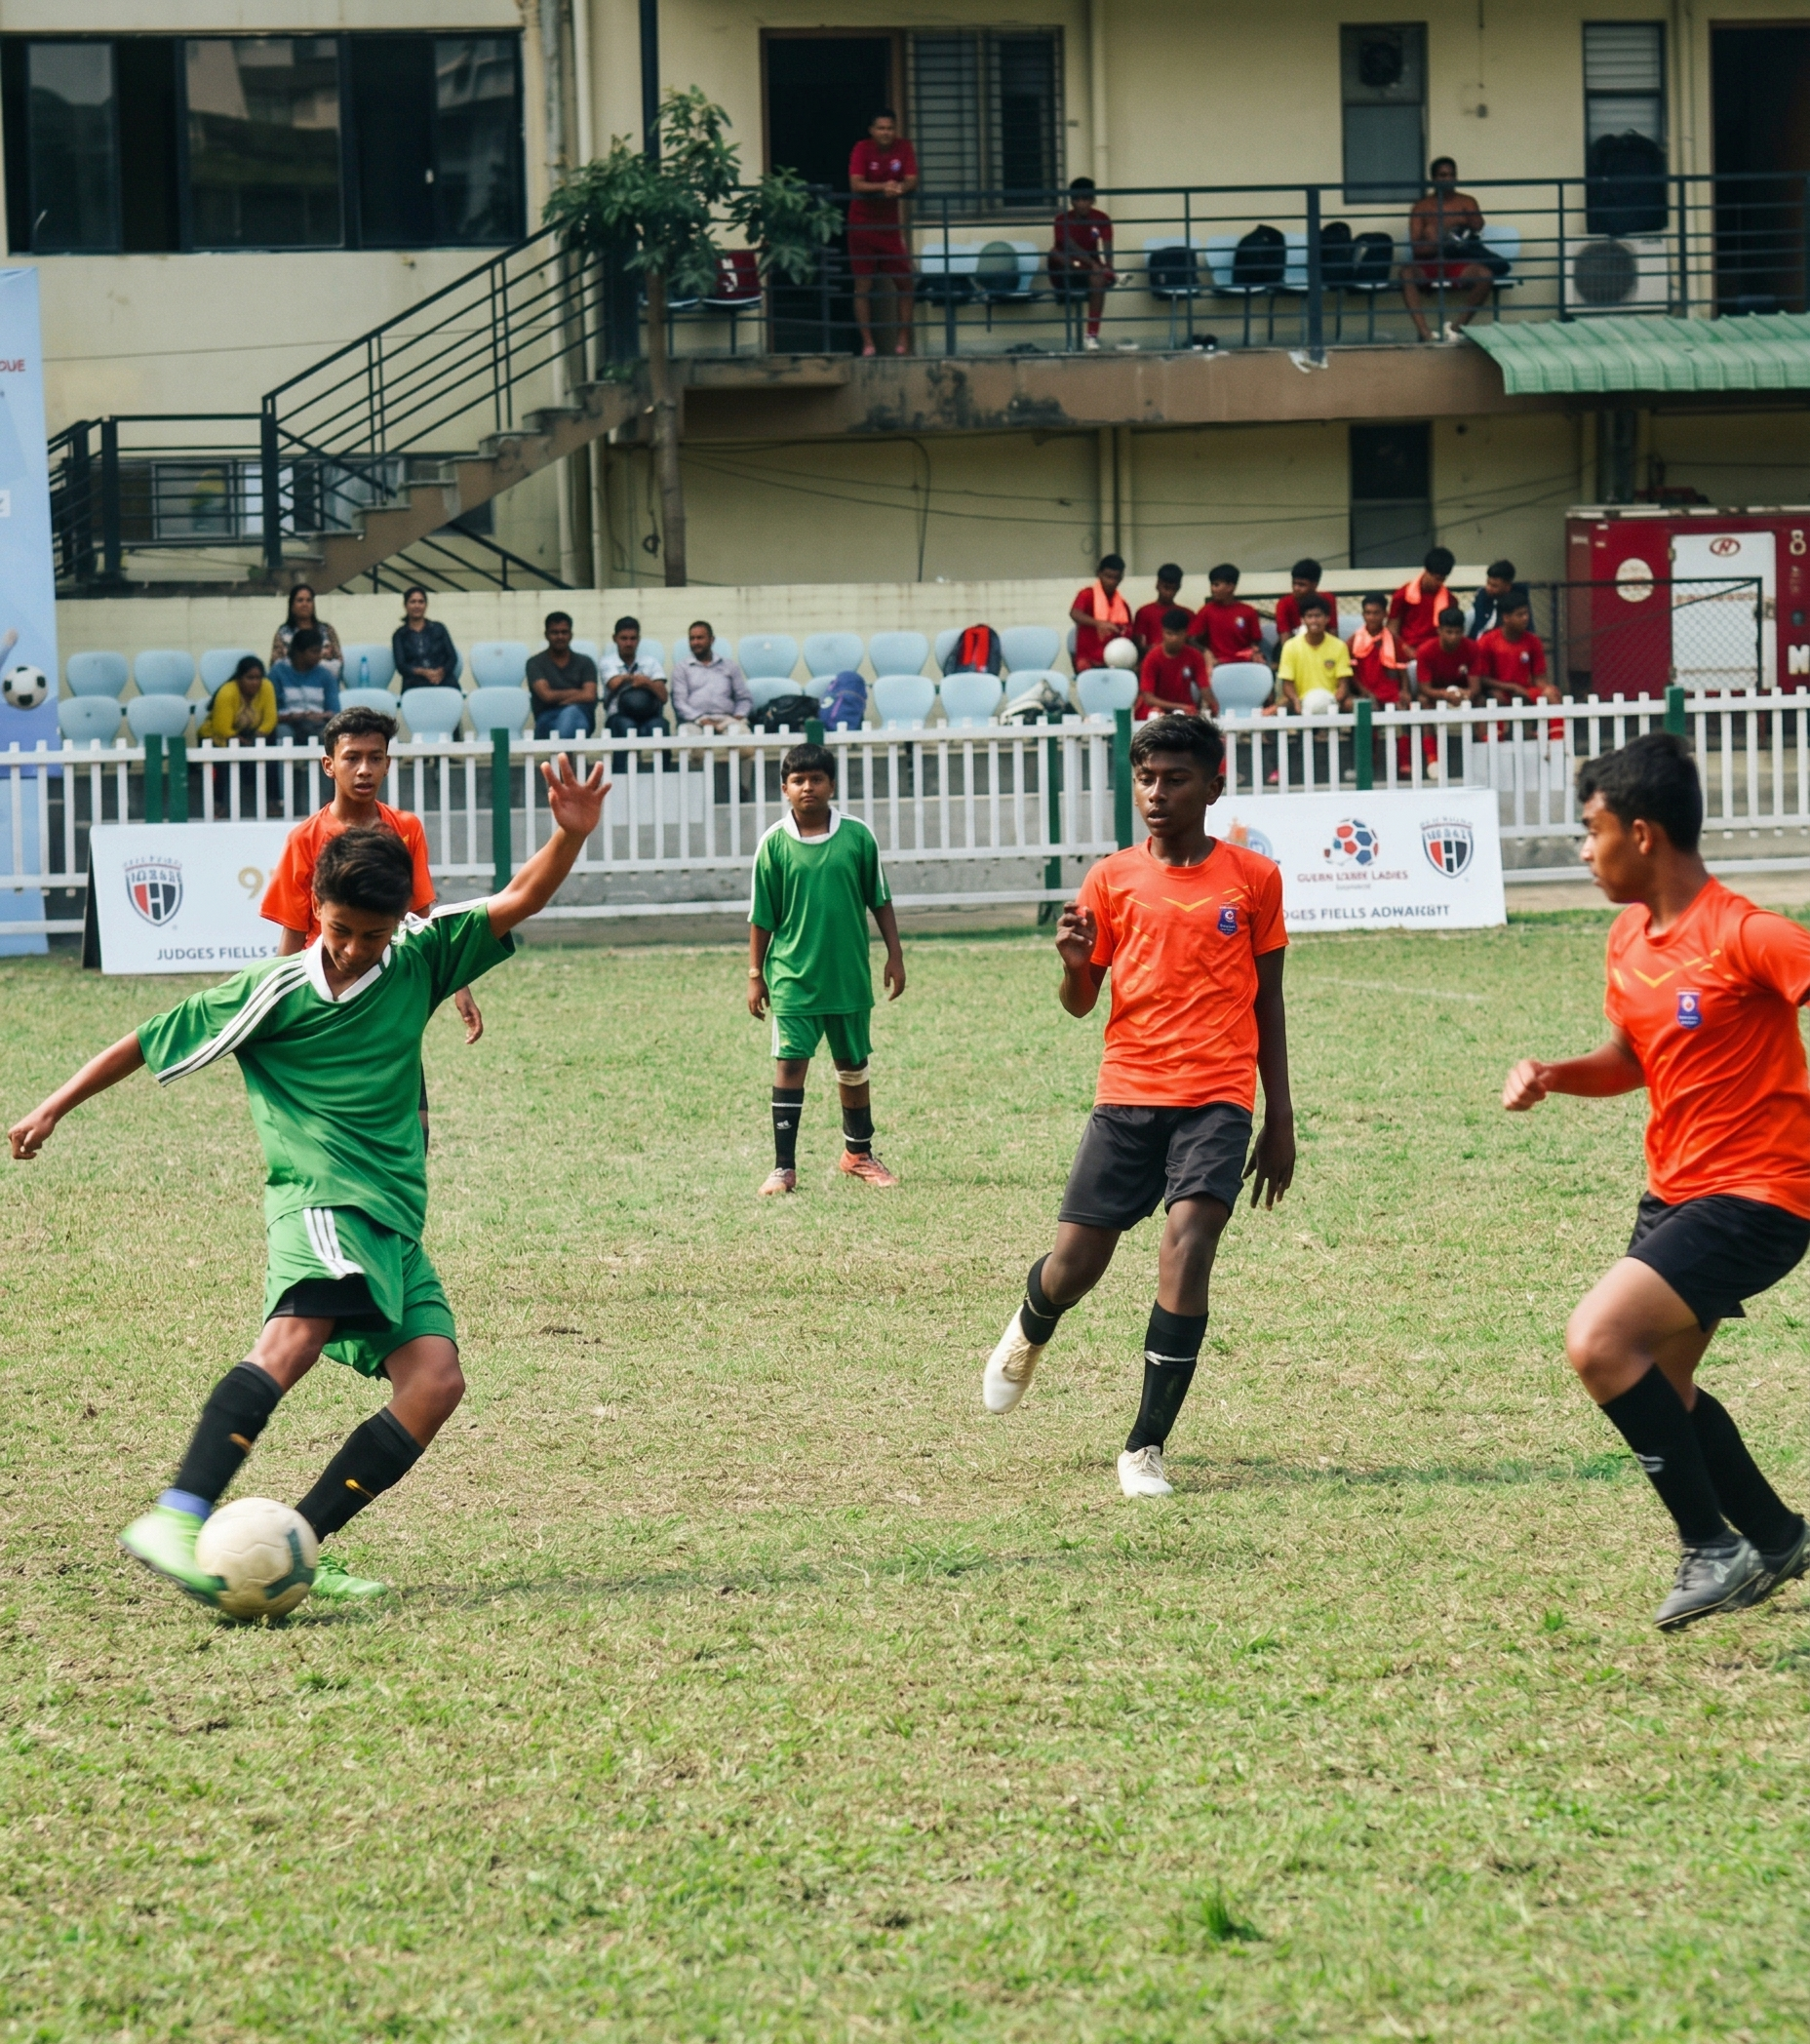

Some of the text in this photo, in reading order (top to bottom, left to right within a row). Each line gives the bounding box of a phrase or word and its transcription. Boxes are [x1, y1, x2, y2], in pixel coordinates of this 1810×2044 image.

[1790, 530, 1806, 556] 8
[1320, 907, 1366, 920] FIELLS
[157, 947, 215, 961] JUDGES
[219, 946, 267, 959] FIELLS
